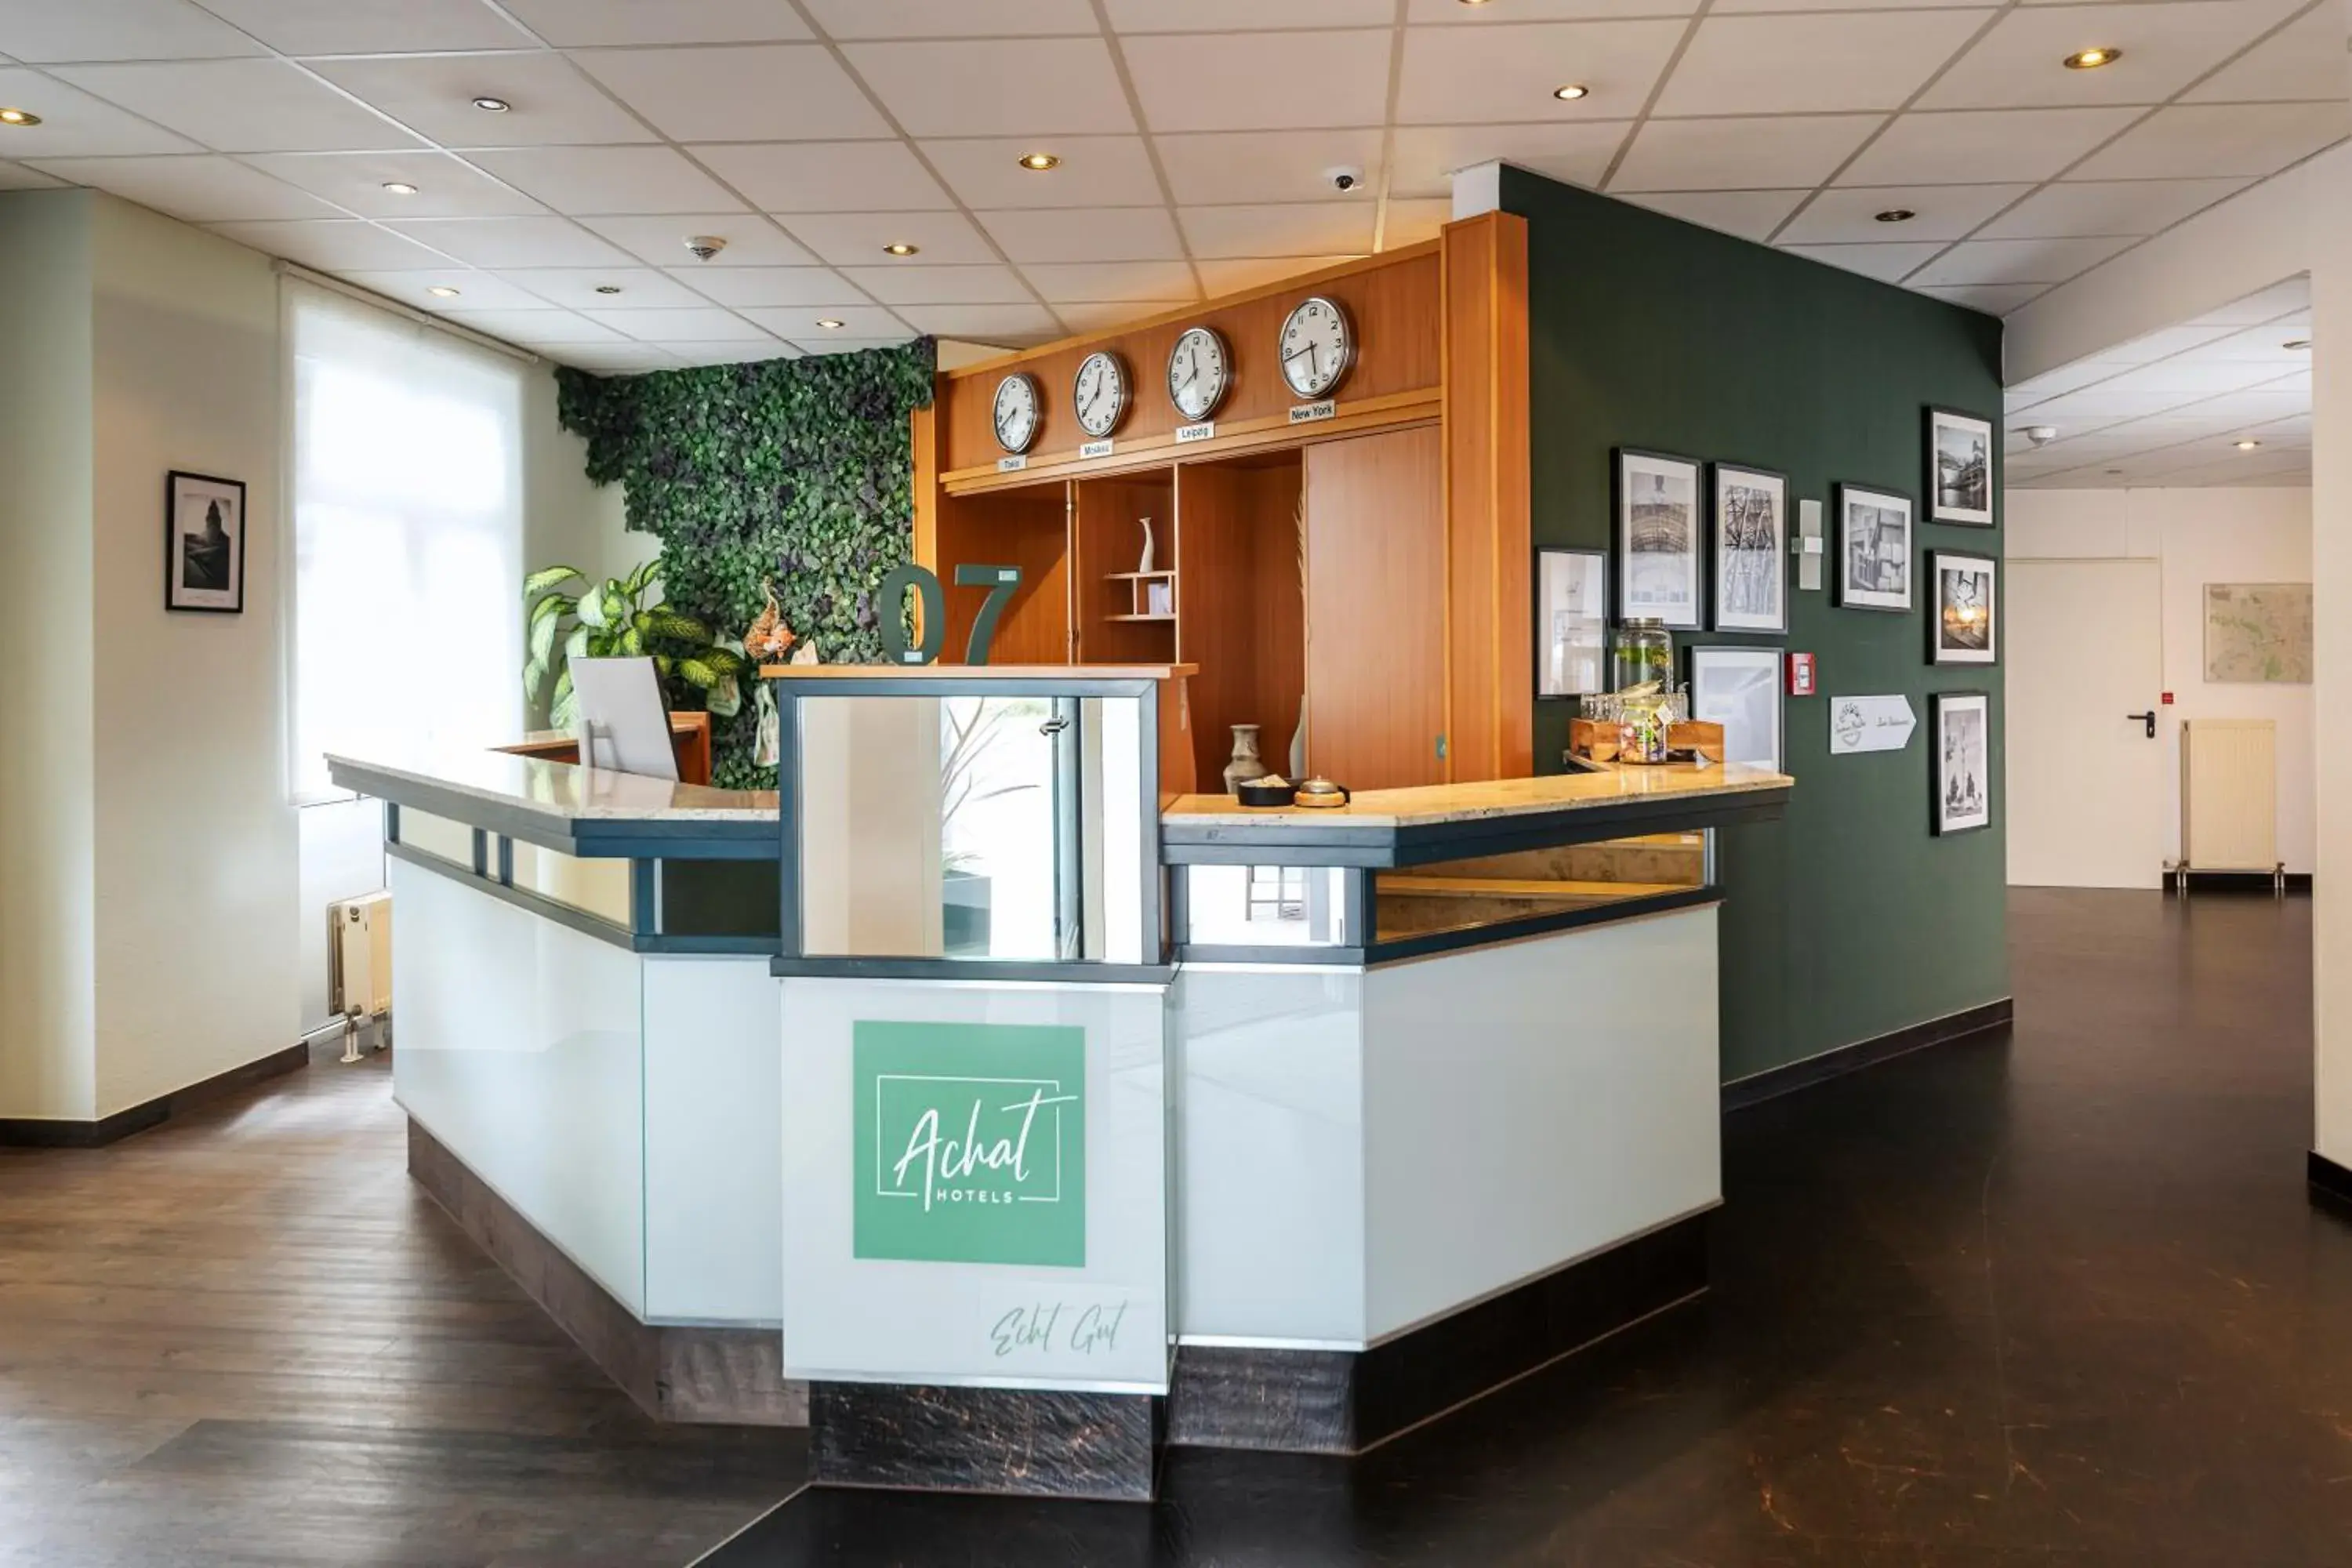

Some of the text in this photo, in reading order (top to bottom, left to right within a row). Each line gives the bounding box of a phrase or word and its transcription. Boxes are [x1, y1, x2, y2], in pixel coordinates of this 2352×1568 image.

[1292, 404, 1332, 421] New York
[880, 564, 1022, 666] 07
[893, 1087, 1079, 1213] Achat
[937, 1189, 1013, 1203] HOTELS
[990, 1298, 1135, 1357] Echt Gut
